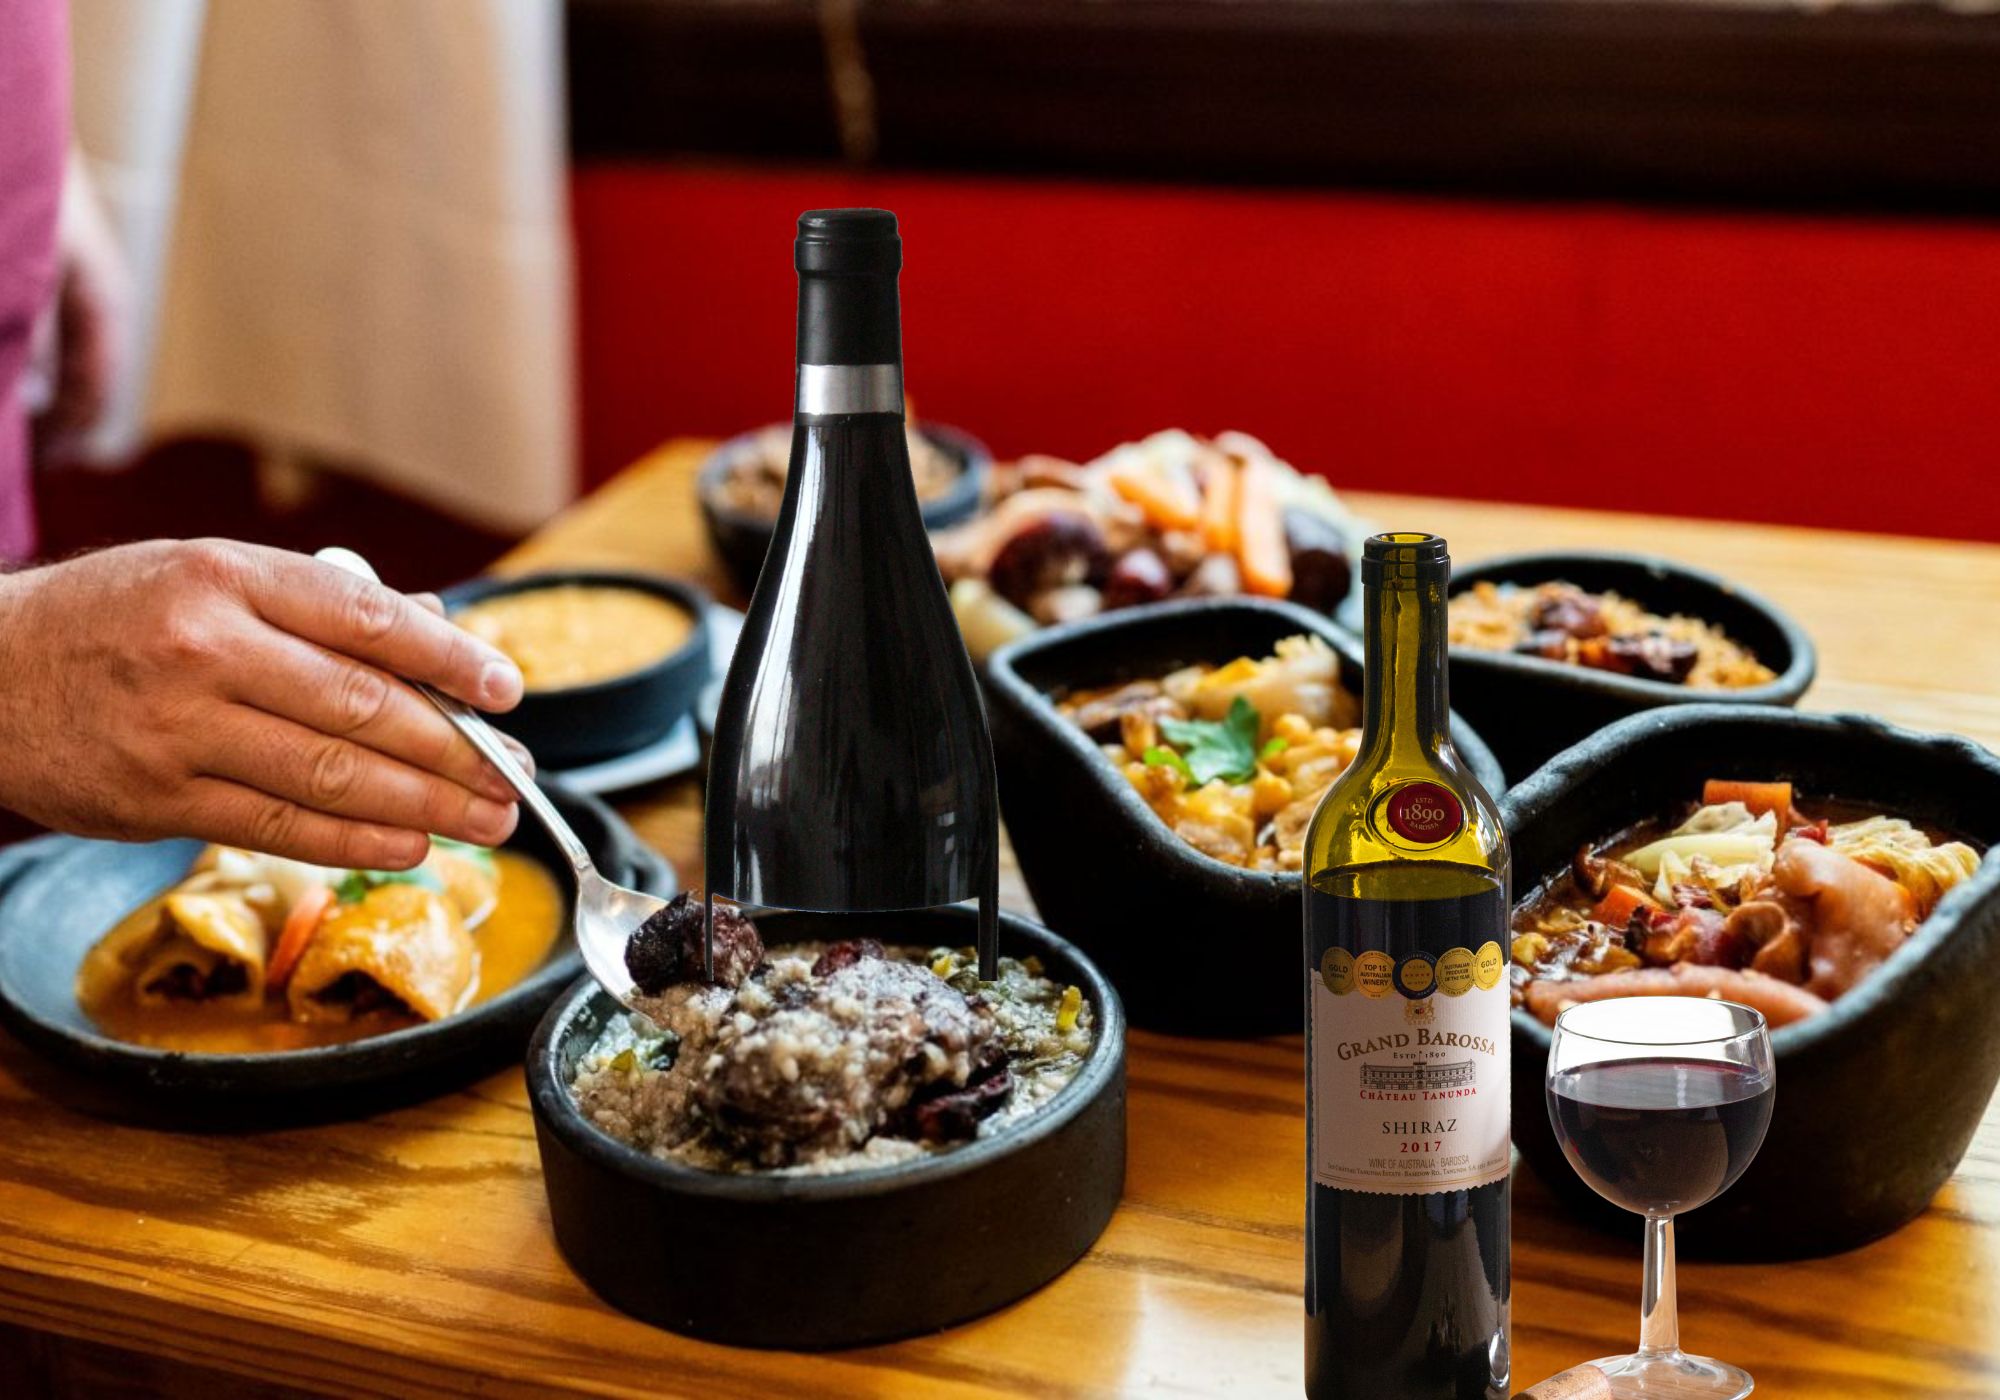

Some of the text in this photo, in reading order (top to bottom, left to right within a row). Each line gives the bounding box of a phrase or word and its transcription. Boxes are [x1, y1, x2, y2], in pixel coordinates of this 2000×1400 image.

[1404, 803, 1445, 823] 1890
[1328, 964, 1348, 973] GOLD
[1481, 958, 1497, 968] GOLD
[1337, 1028, 1495, 1061] GRAND BAROSSA
[1425, 1051, 1446, 1059] 1890
[1360, 1088, 1477, 1101] CHÂTEAU TANUNDA
[1382, 1119, 1457, 1135] SHIRAZ
[1400, 1141, 1441, 1153] 2017
[1368, 1159, 1386, 1168] WINE
[1388, 1160, 1397, 1168] OF
[1399, 1158, 1436, 1169] AUSTRALIA
[1440, 1155, 1470, 1168] BAROSSA
